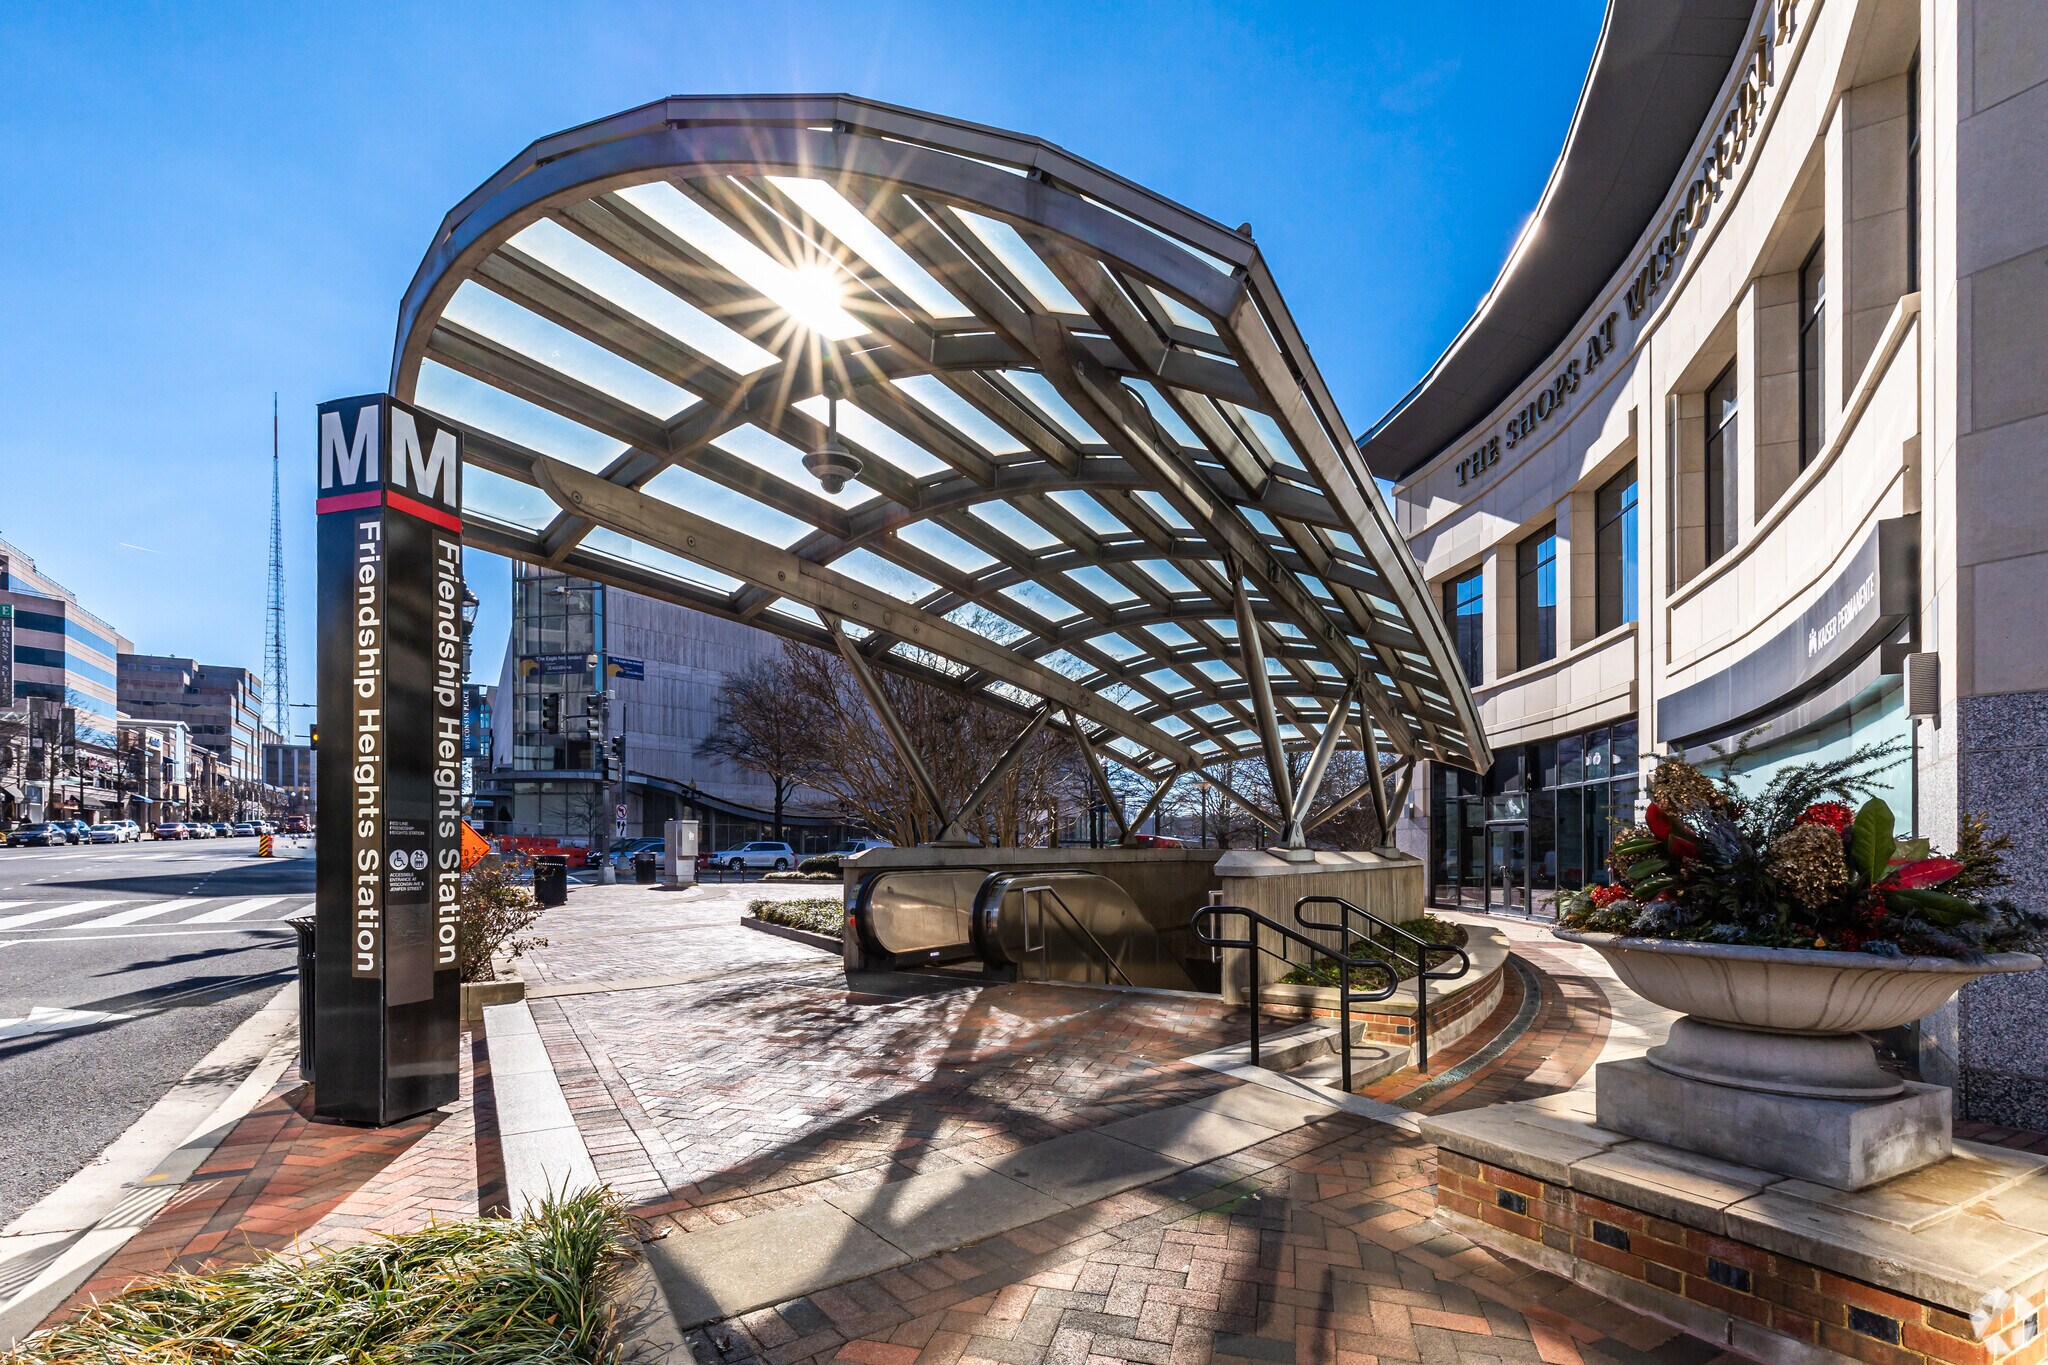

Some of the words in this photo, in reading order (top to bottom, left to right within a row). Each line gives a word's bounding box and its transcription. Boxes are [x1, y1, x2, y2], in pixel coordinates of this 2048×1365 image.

[1455, 435, 1500, 487] THE
[1506, 359, 1580, 449] SHOPS
[1584, 311, 1617, 375] AT
[1622, 35, 1768, 321] WISCONSIN
[322, 404, 378, 489] M
[392, 406, 456, 508] M
[354, 521, 380, 698] Friendship
[433, 539, 460, 706] Friendship
[1818, 616, 1837, 650] KAISER
[1838, 572, 1874, 633] PERMANENTE
[354, 709, 380, 838] Heights
[434, 716, 460, 838] Heights
[357, 849, 379, 971] Station
[439, 848, 460, 964] Station
